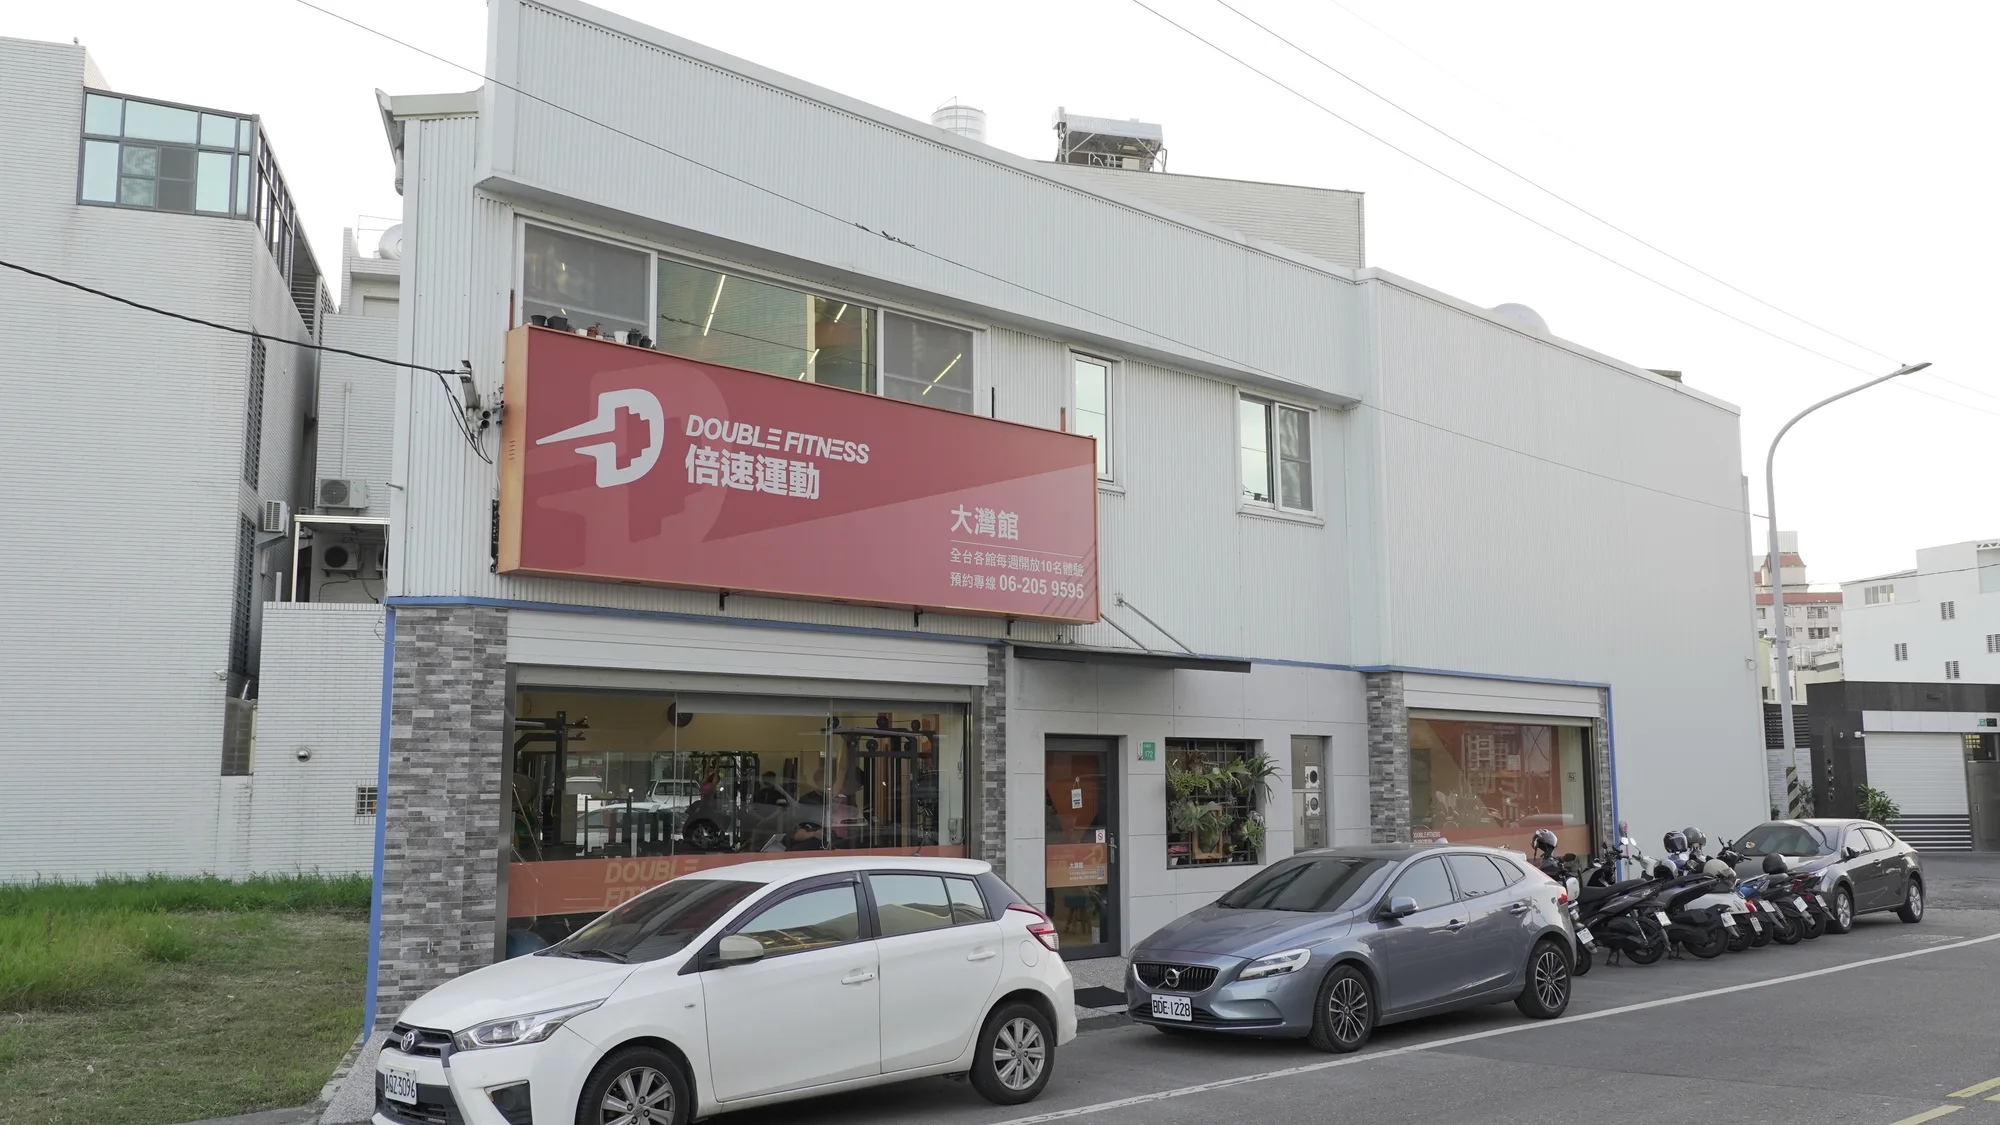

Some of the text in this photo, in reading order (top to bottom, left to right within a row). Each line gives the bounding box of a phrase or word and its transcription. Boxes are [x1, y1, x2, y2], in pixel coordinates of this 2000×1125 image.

[686, 414, 870, 464] DOUBLE FITNESS
[685, 443, 820, 500] 倍速運動
[950, 504, 1019, 540] 大灣館
[950, 572, 1084, 599] 預約專線 06-205 9595
